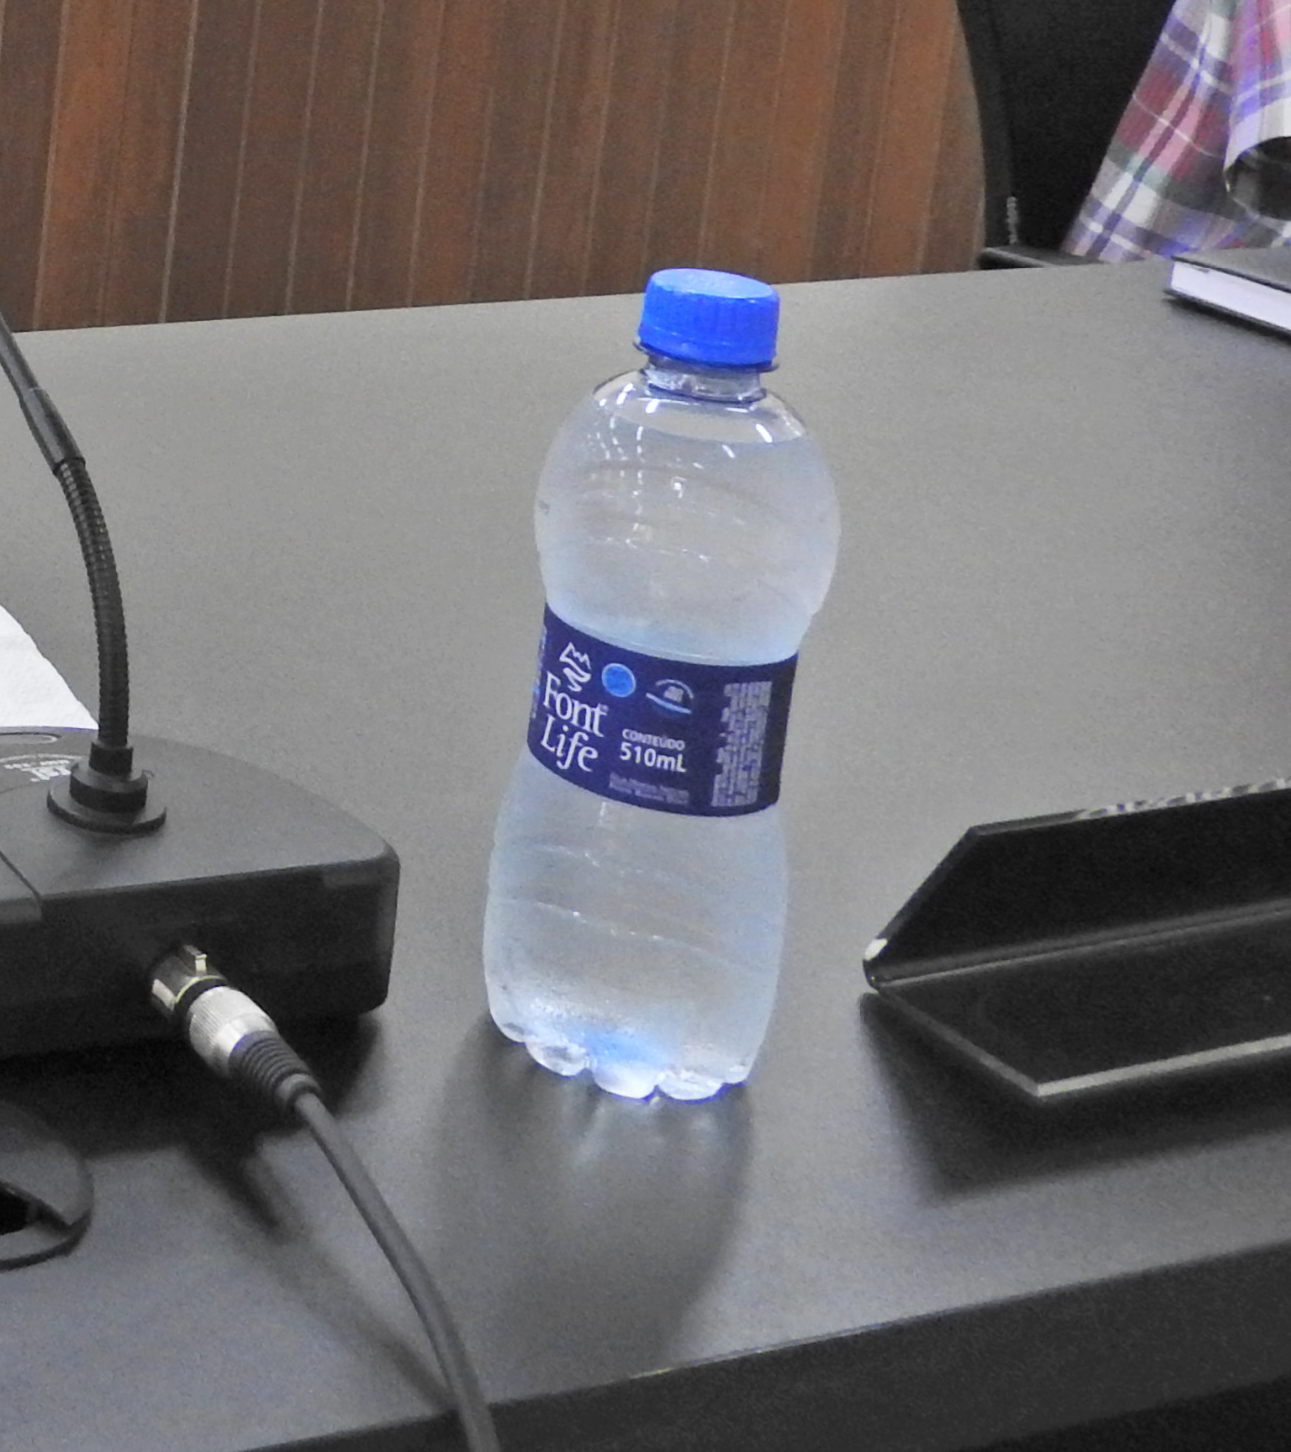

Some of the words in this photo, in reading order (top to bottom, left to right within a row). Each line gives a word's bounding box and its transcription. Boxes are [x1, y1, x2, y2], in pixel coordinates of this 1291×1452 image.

[543, 673, 606, 738] Font
[540, 718, 598, 772] Life
[619, 743, 687, 773] 510mL
[622, 727, 686, 752] CONTEÚDO
